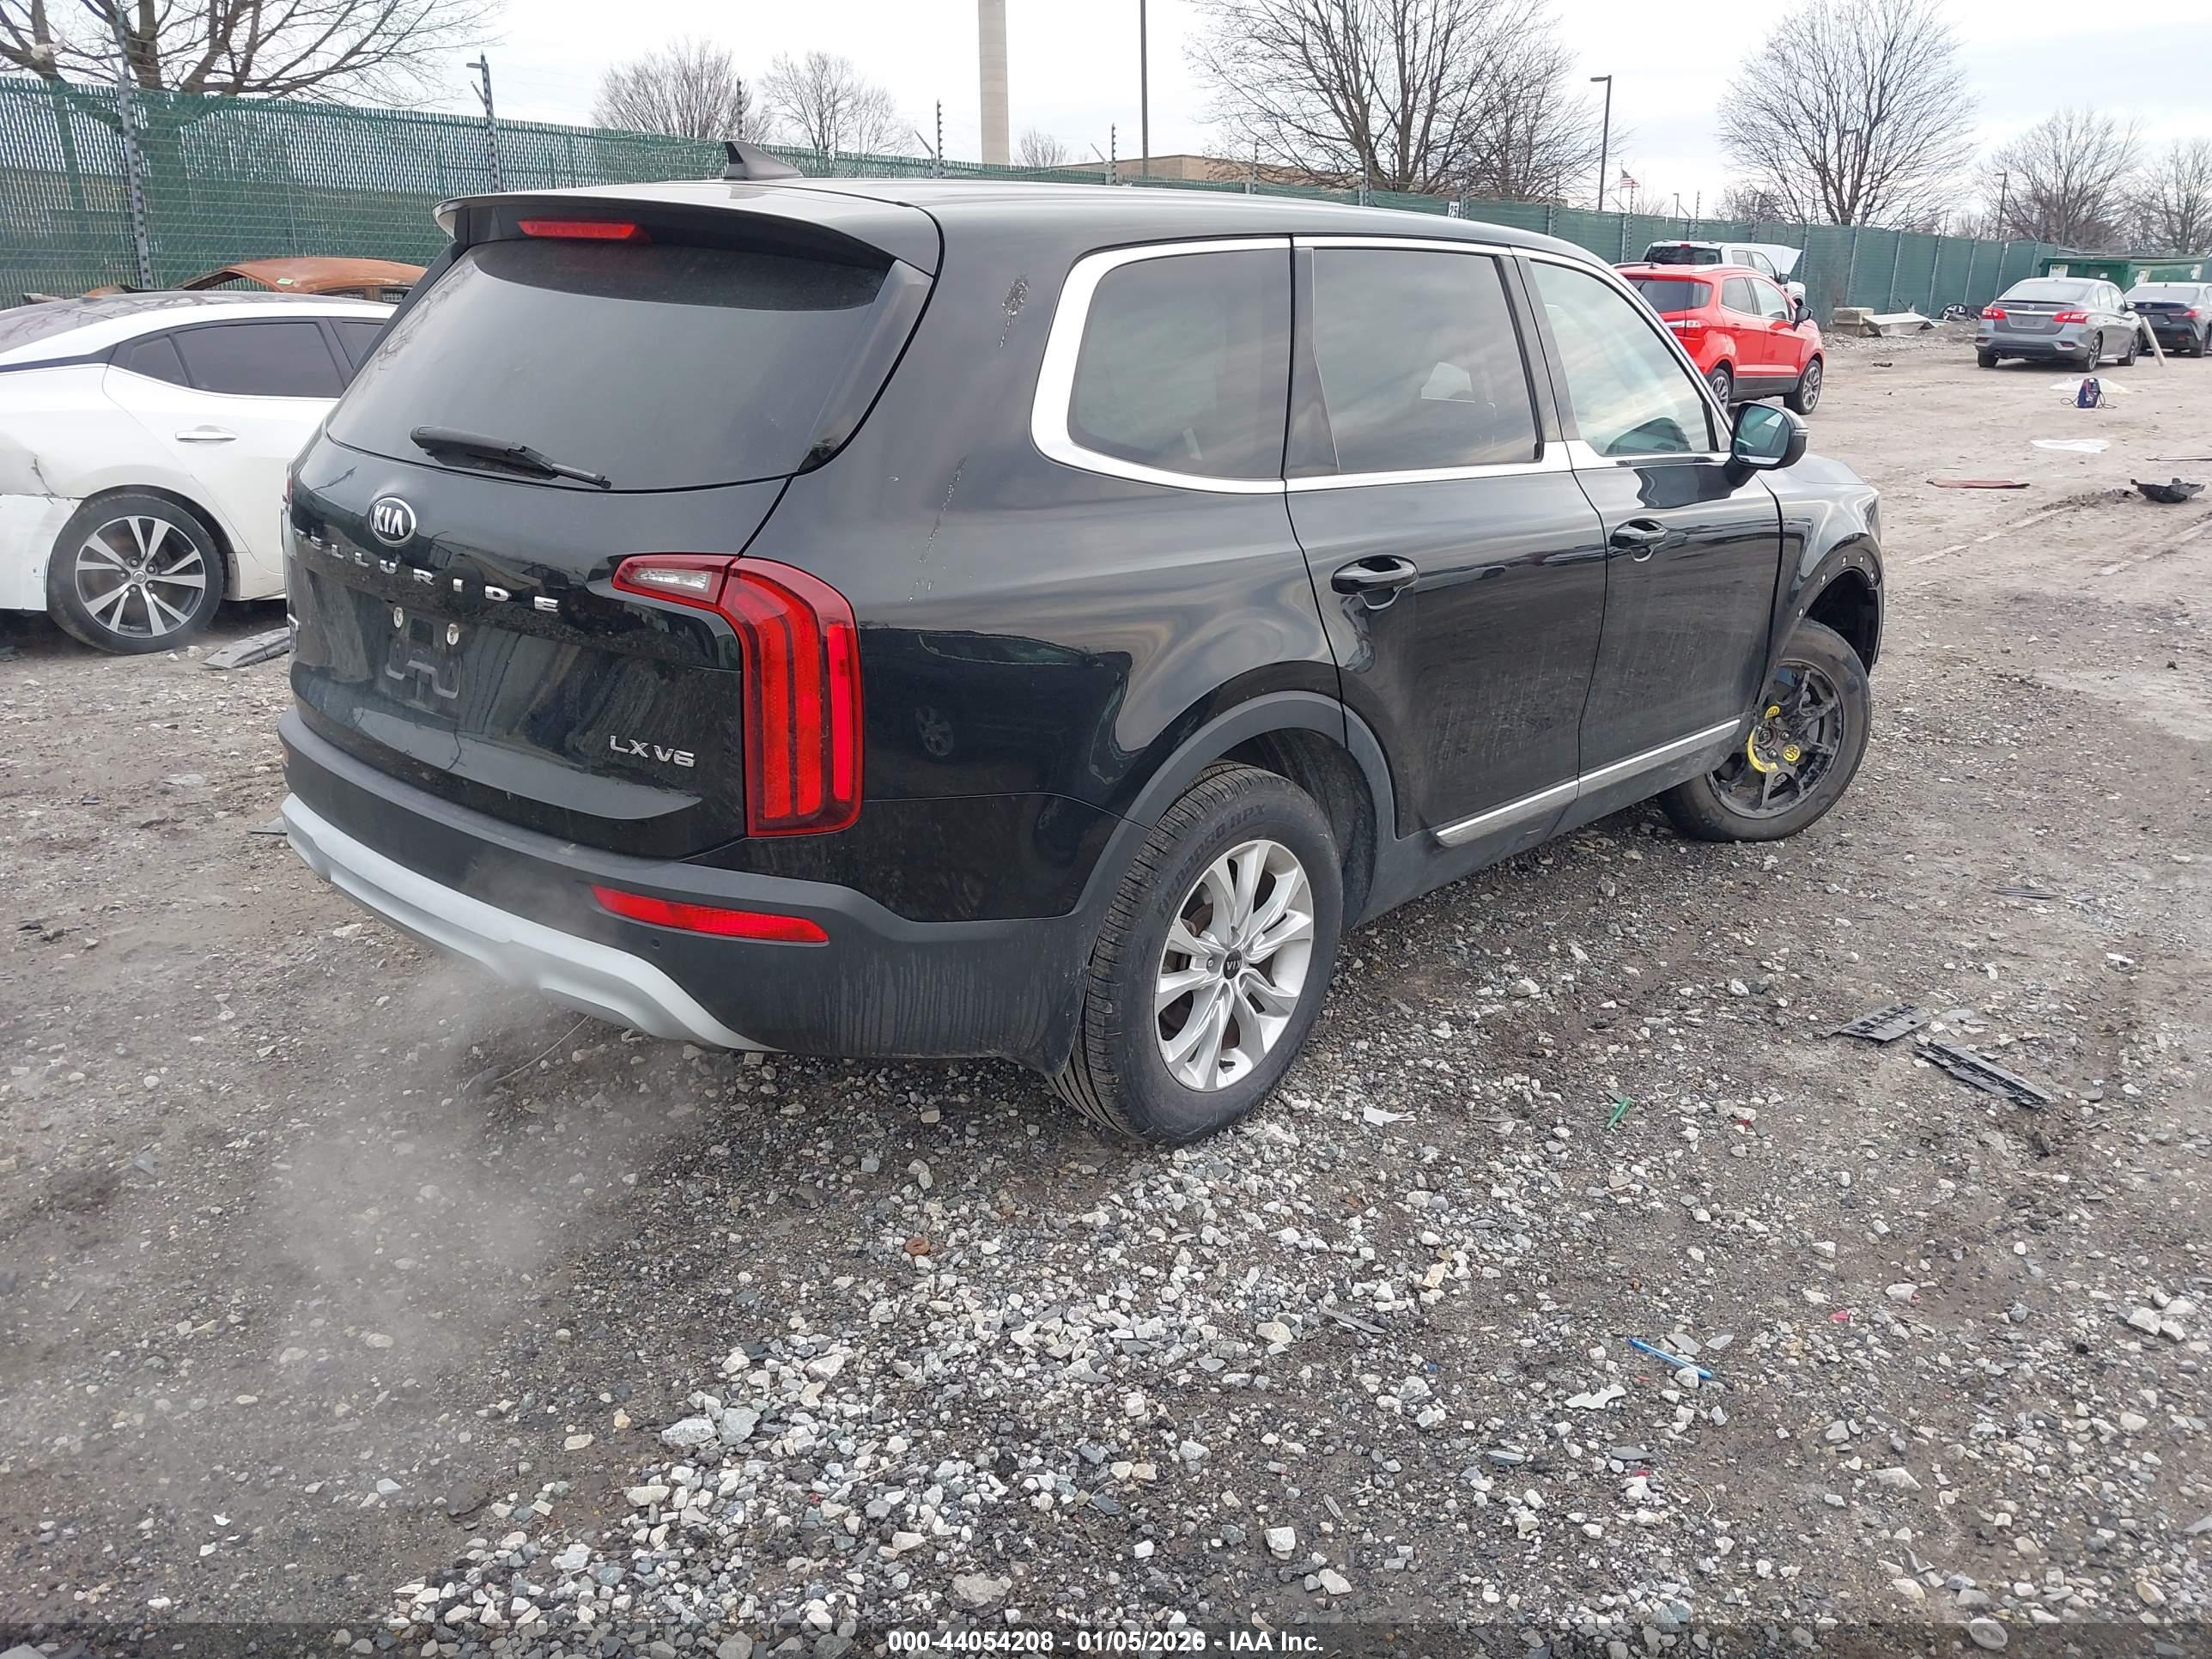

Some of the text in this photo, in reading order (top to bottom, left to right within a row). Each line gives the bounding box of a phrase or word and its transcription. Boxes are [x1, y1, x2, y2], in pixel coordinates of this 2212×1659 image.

[1449, 205, 1458, 218] 25
[374, 505, 404, 537] KIA
[295, 528, 559, 612] TELLURIDE
[610, 735, 695, 768] LX V6
